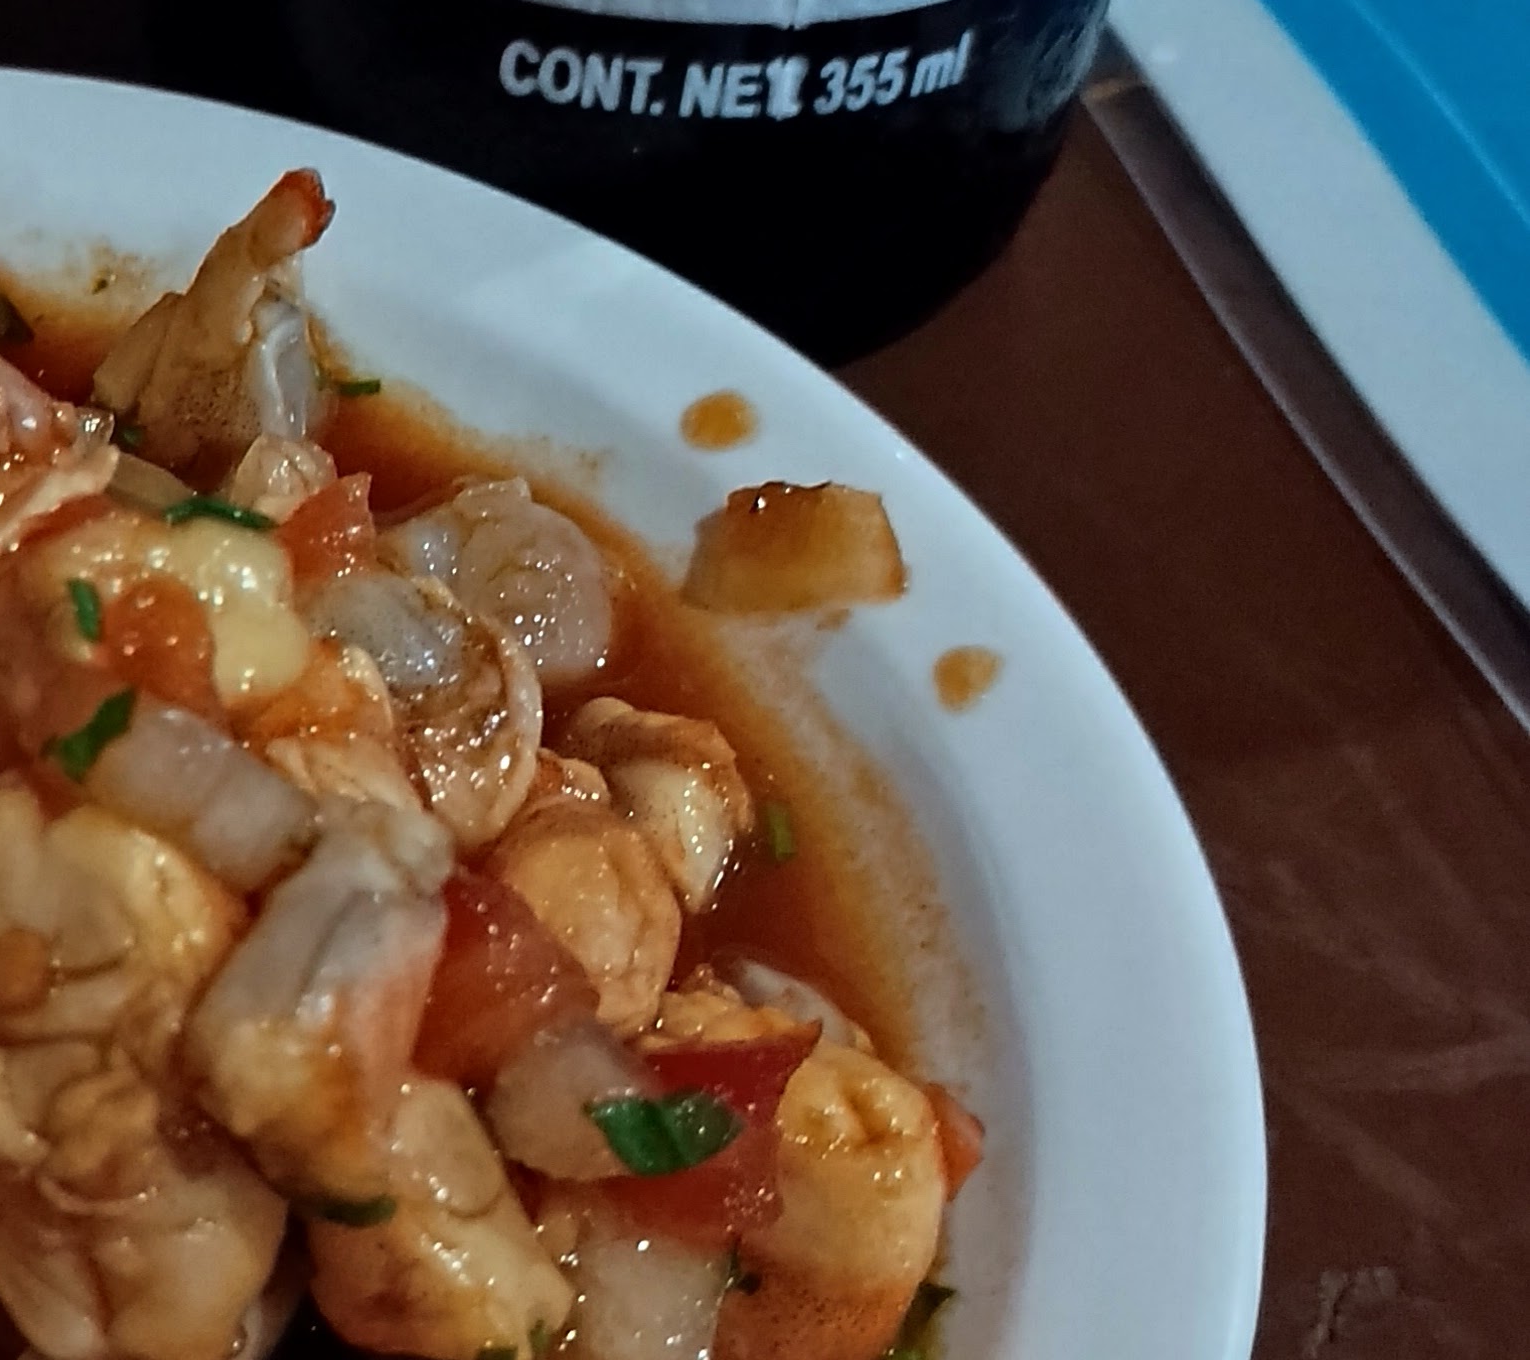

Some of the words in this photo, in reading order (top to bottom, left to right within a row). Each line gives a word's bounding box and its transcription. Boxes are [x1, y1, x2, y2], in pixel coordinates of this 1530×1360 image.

[498, 40, 665, 116] CONT.
[813, 49, 909, 115] 355
[911, 29, 971, 98] ml
